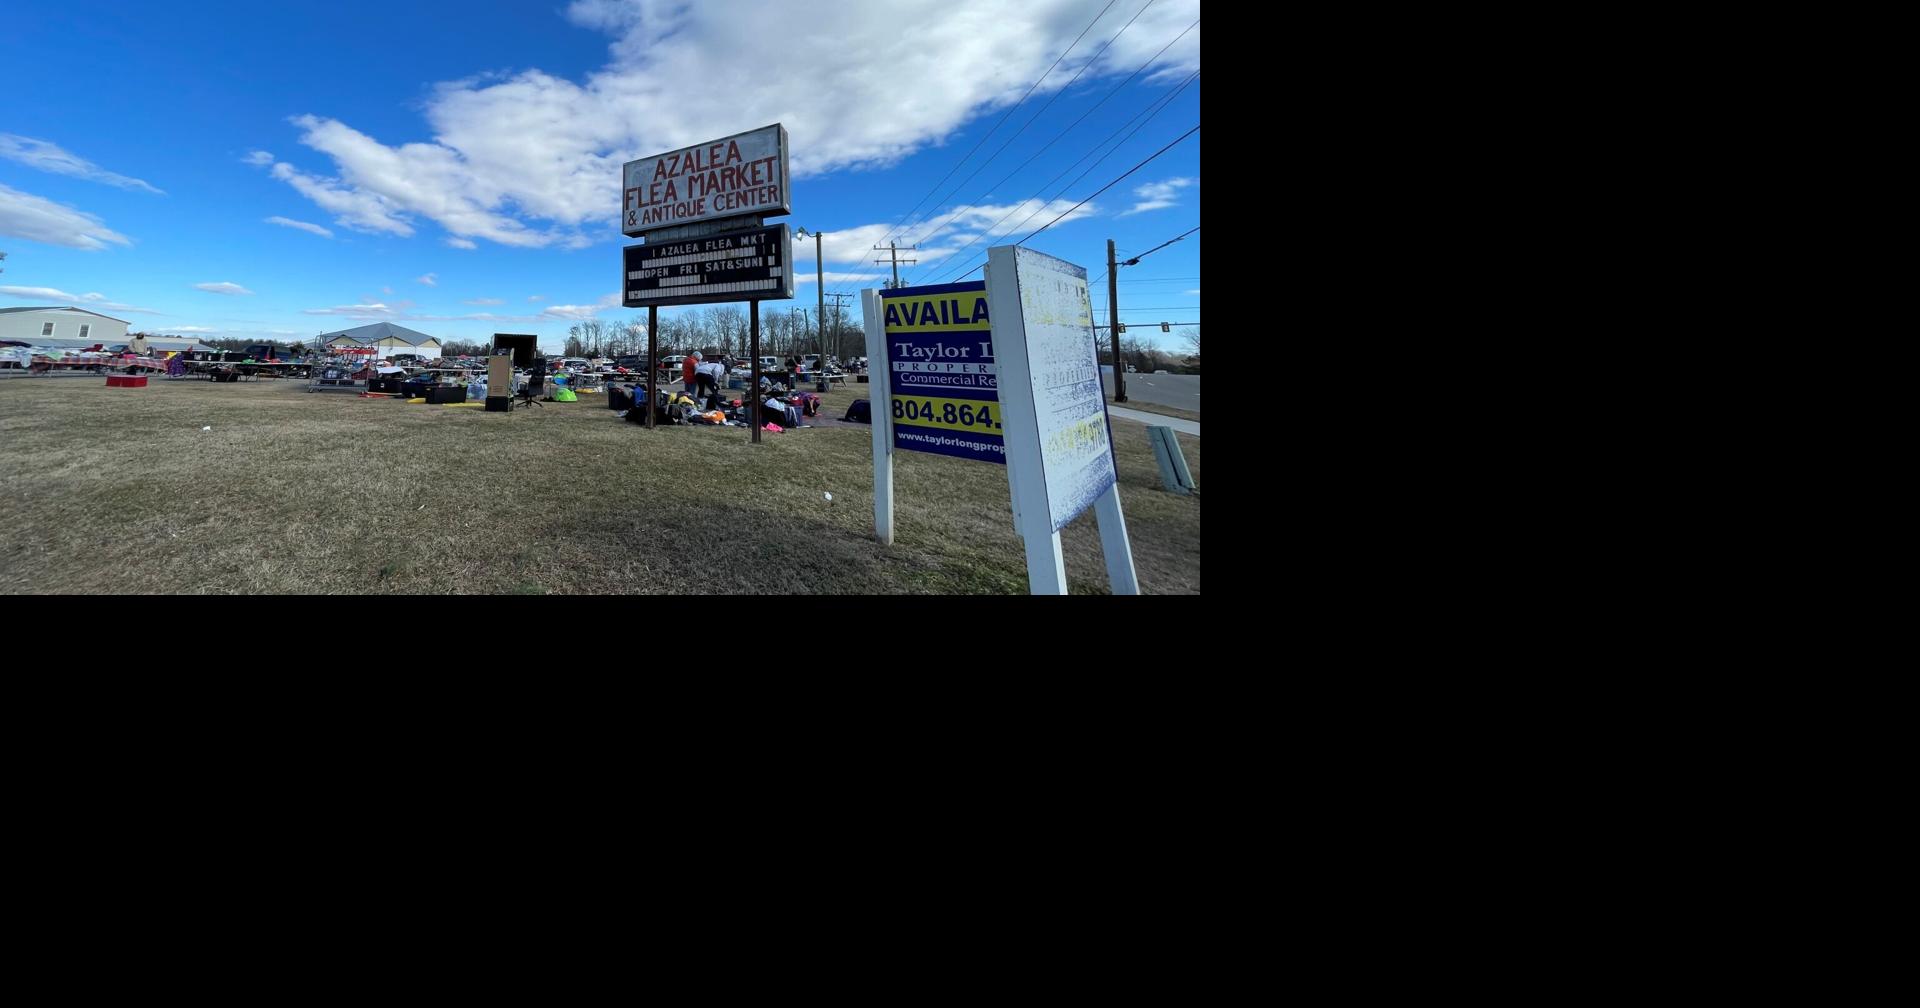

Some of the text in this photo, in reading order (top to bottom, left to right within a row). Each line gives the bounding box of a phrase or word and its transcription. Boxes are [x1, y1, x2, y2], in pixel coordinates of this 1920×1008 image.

[653, 139, 742, 182] AZALEA
[625, 155, 777, 211] FLEA MARKET
[627, 184, 779, 226] & ANTIQUE CENTER
[660, 233, 767, 257] AZALEA FLEA MKT
[644, 267, 669, 278] OPEN
[679, 264, 698, 275] FRI
[885, 297, 990, 327] AVAILA
[895, 342, 970, 362] Taylor
[897, 362, 988, 374] PROPER
[900, 372, 997, 387] Commercial Re
[897, 432, 1006, 454] www.taylorlongprop
